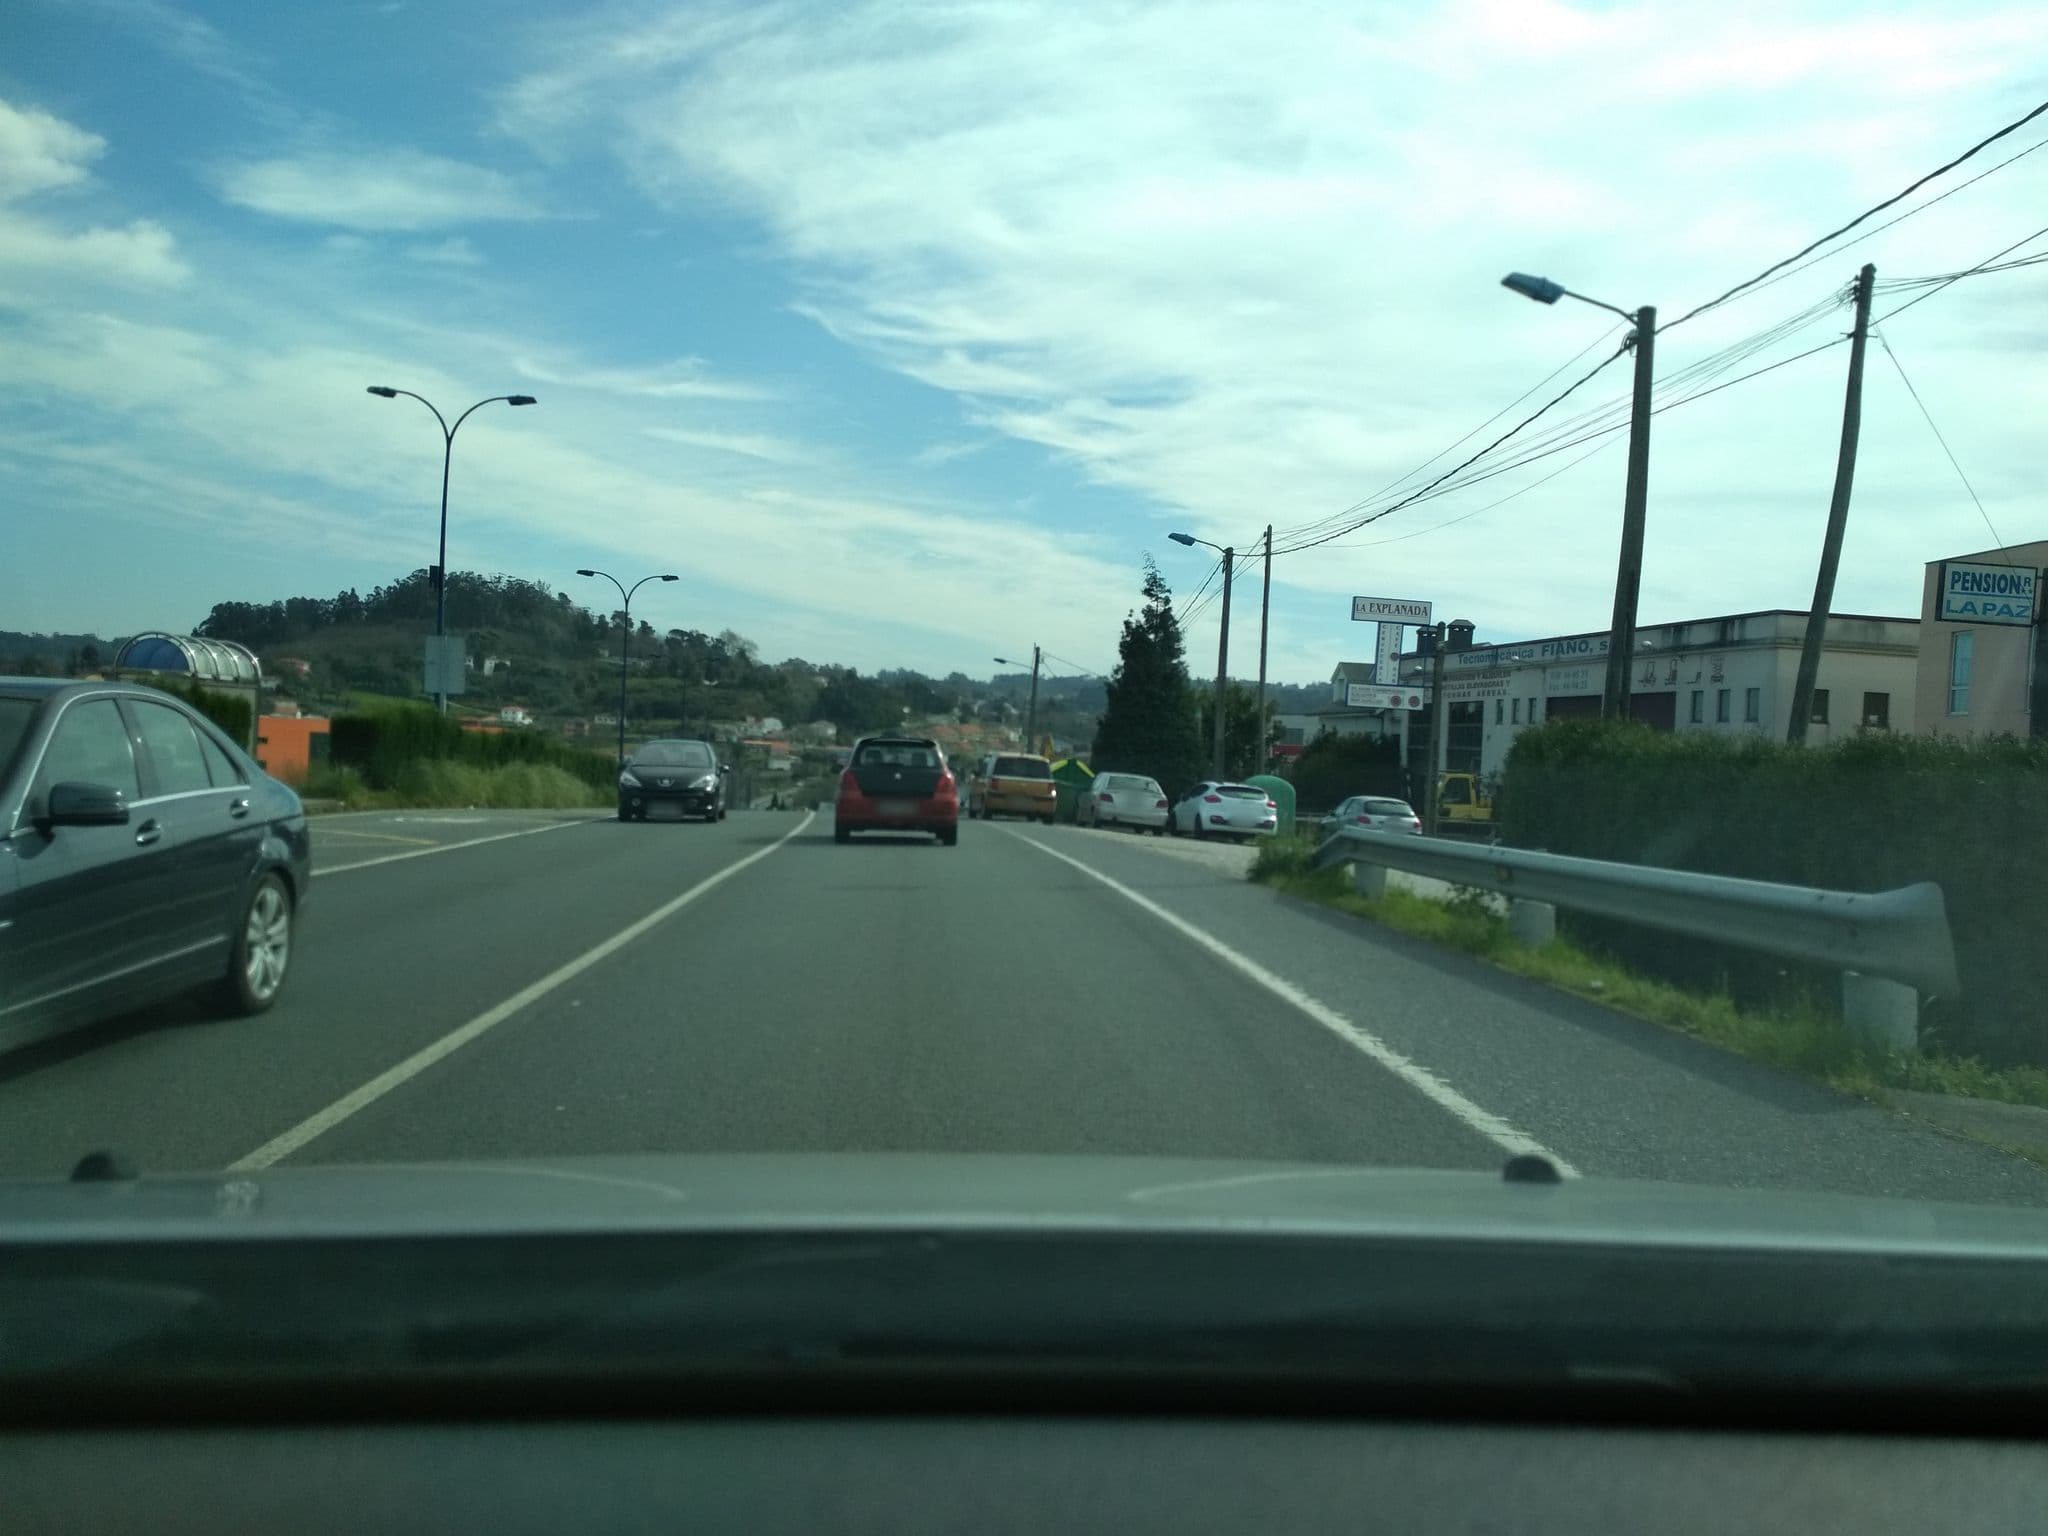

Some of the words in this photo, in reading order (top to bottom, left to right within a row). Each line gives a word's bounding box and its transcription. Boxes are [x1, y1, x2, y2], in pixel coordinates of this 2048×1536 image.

[1951, 571, 2021, 594] PENSION
[1356, 603, 1367, 613] LA
[1369, 602, 1428, 617] EXPLANADA
[1946, 600, 1978, 615] LA
[1982, 603, 2032, 617] PAZ
